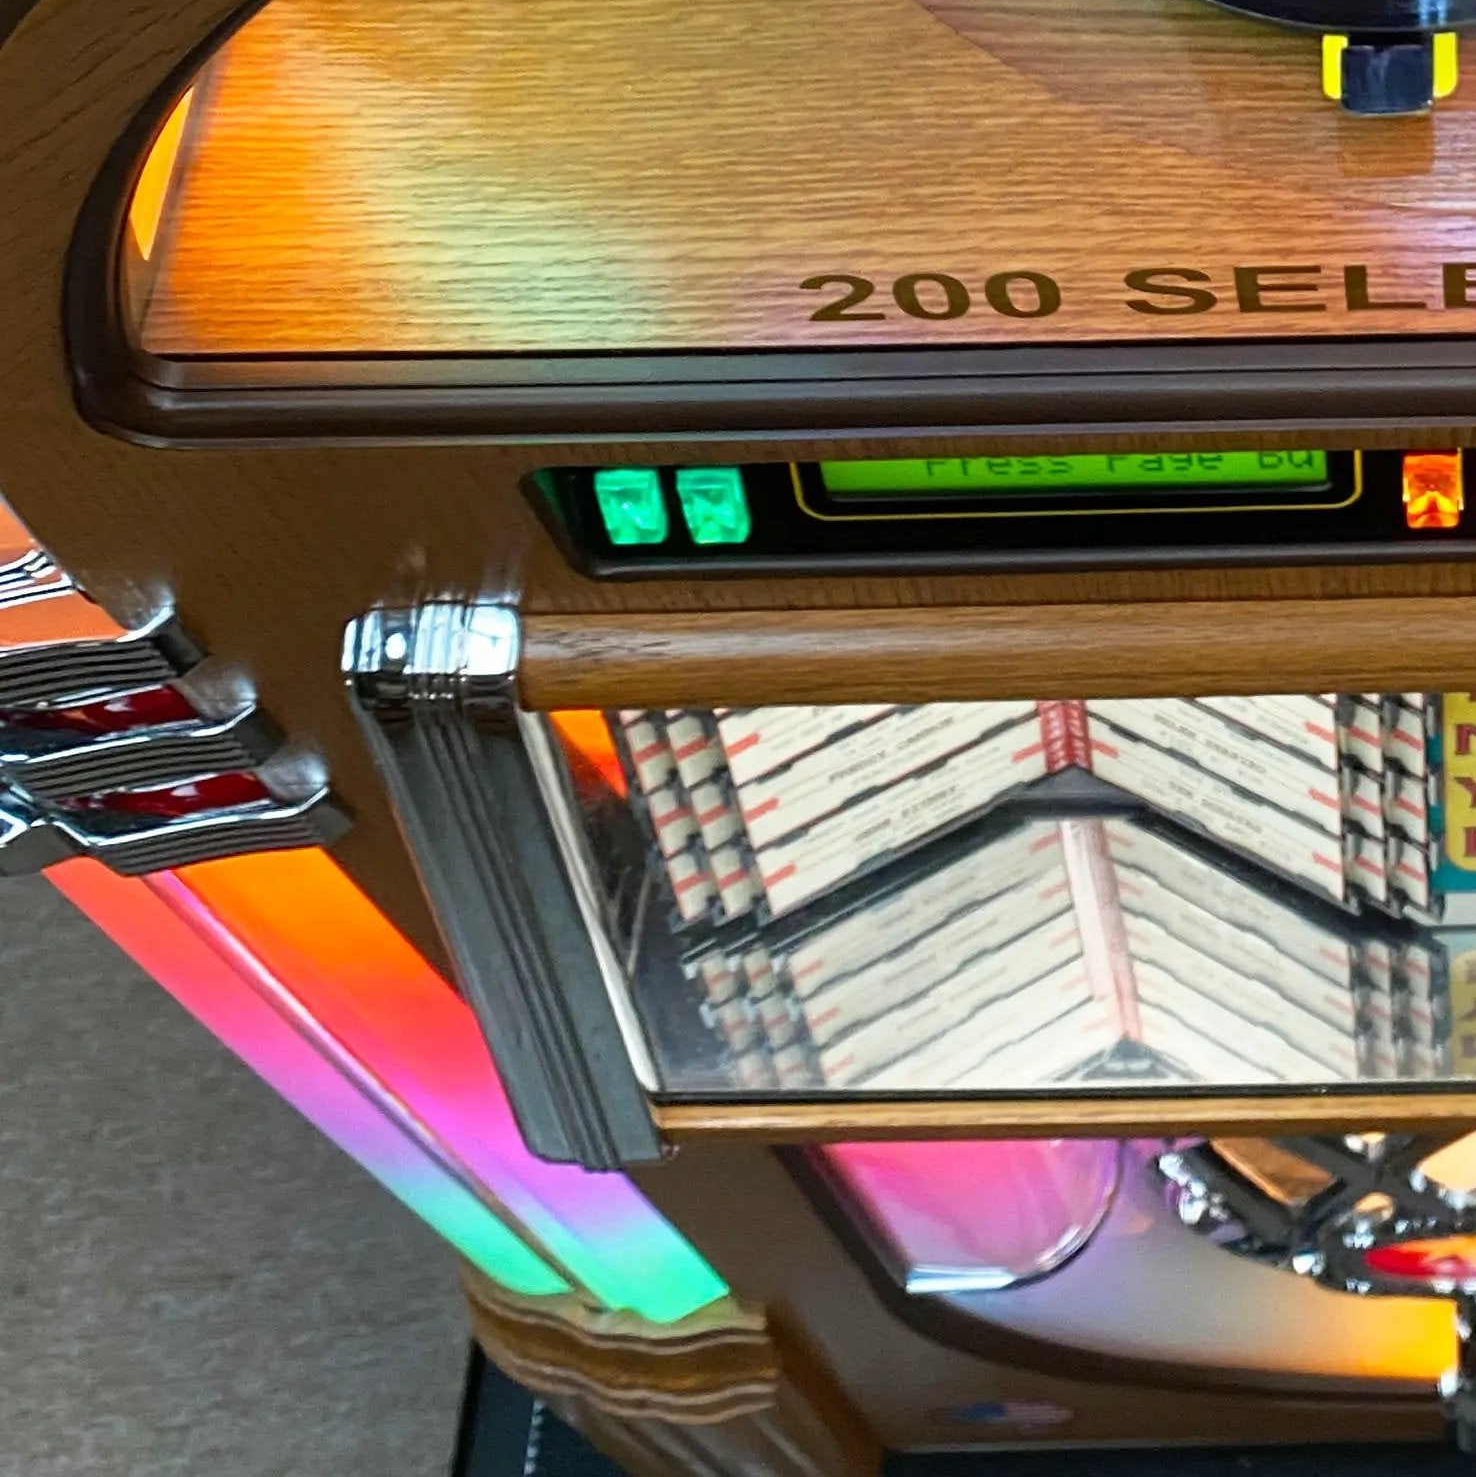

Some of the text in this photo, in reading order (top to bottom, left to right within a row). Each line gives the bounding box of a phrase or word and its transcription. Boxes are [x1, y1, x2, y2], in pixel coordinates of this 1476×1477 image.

[801, 271, 1061, 322] 200
[925, 457, 1075, 477] Press
[1105, 453, 1224, 473] Page
